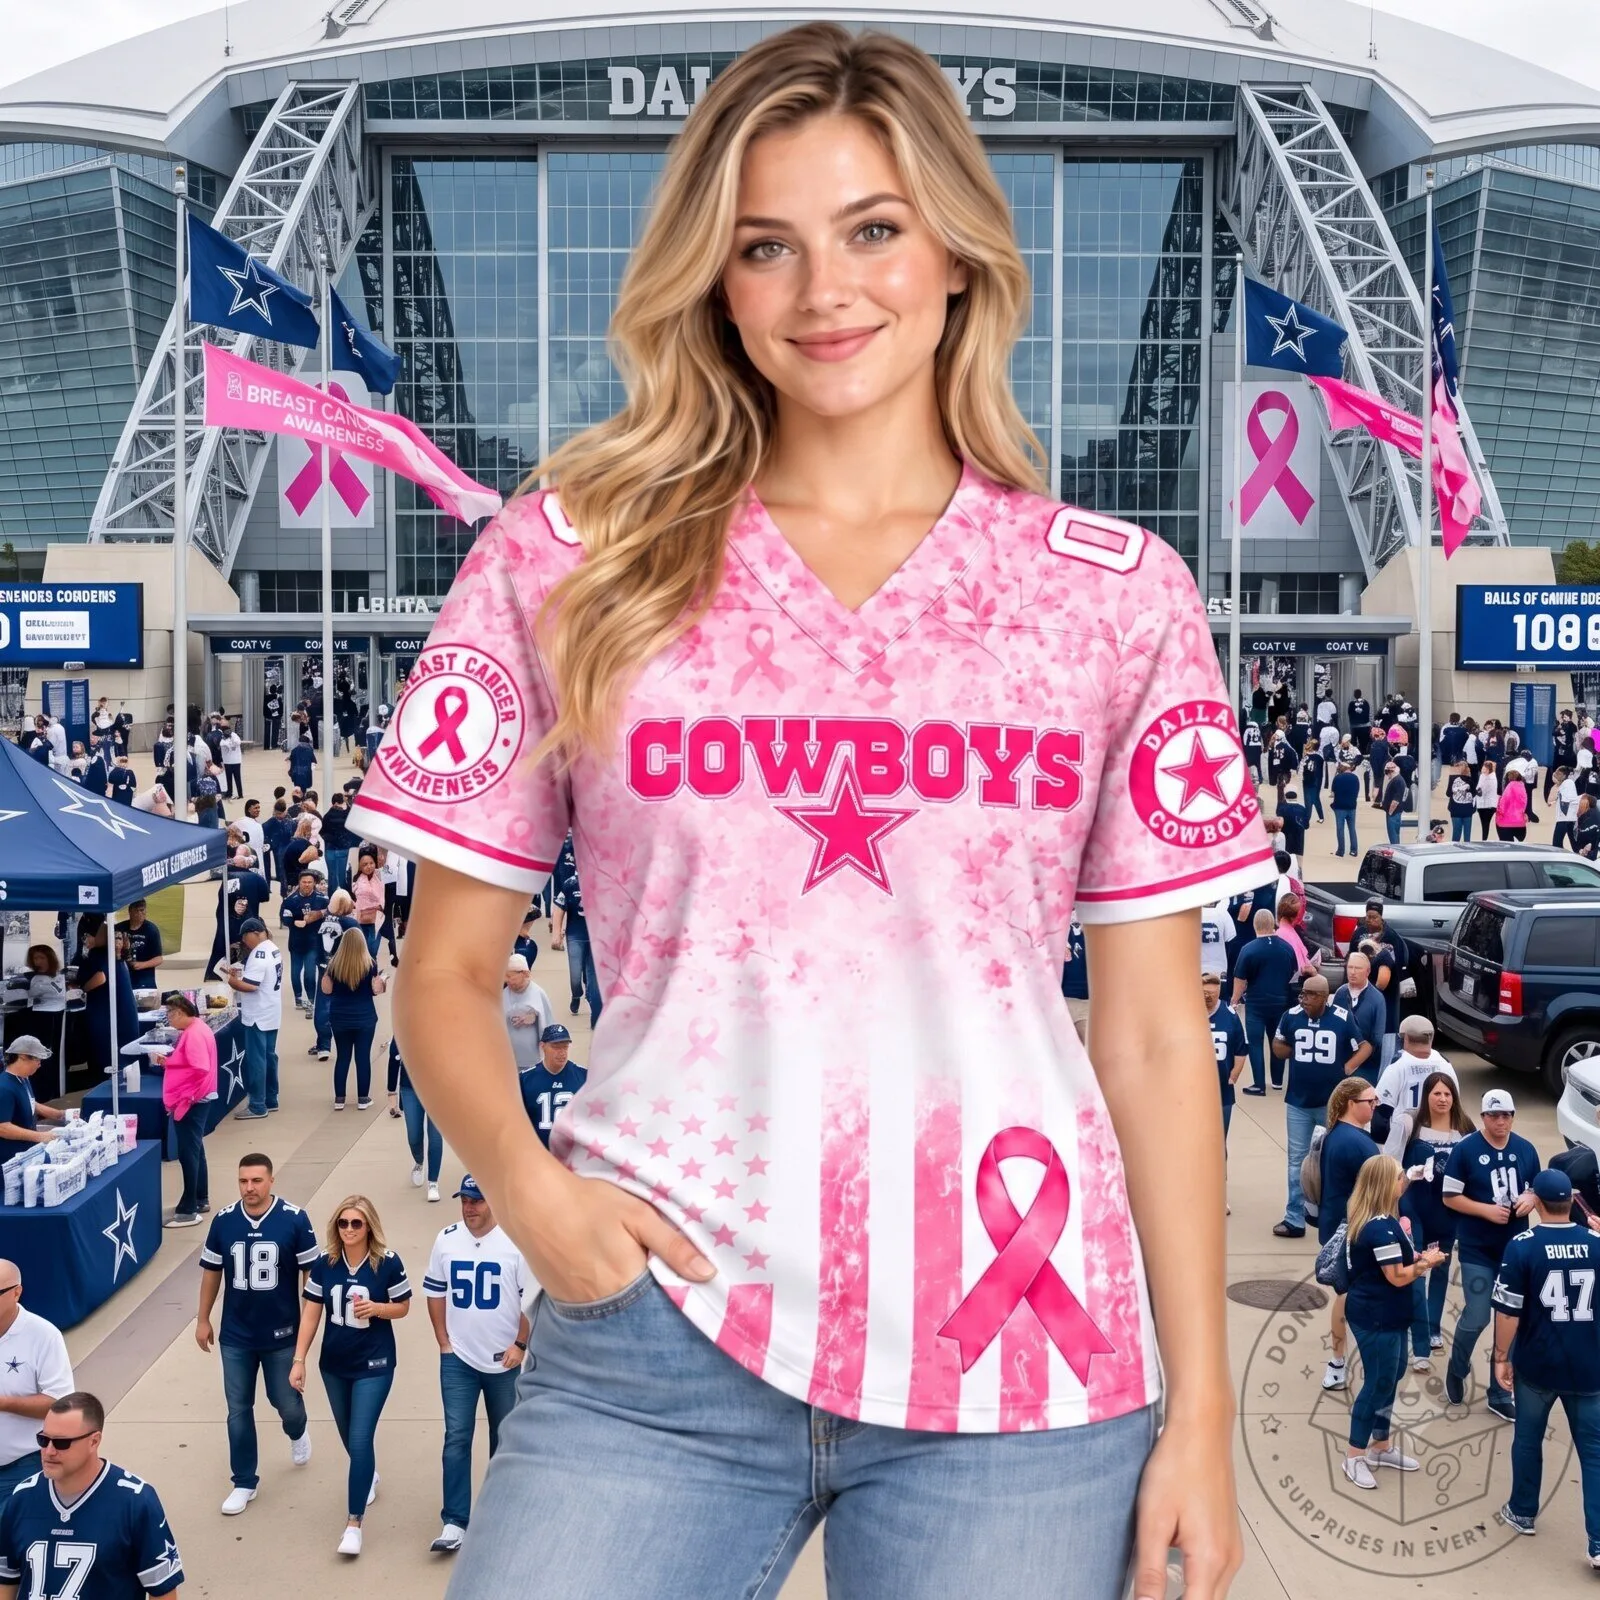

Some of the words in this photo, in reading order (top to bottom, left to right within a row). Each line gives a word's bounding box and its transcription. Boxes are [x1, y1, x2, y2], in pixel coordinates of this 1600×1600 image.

[247, 385, 316, 414] BREAST
[283, 414, 385, 452] AWARENESS
[1484, 591, 1520, 605] BALLS
[1523, 591, 1539, 605] OF
[231, 639, 256, 650] COAT
[395, 640, 421, 650] COAT
[1252, 642, 1281, 651] COAT
[1284, 642, 1296, 651] VE
[1326, 642, 1351, 651] COAT
[1356, 642, 1369, 651] VE
[404, 653, 457, 692] EAST
[381, 745, 499, 796] AWARENESS
[626, 715, 1084, 812] COWBOYS
[1149, 794, 1258, 844] COWBOYS
[1294, 1028, 1336, 1064] 29
[230, 1241, 279, 1290] 18
[1539, 1269, 1595, 1321] 47
[26, 1540, 97, 1600] 17
